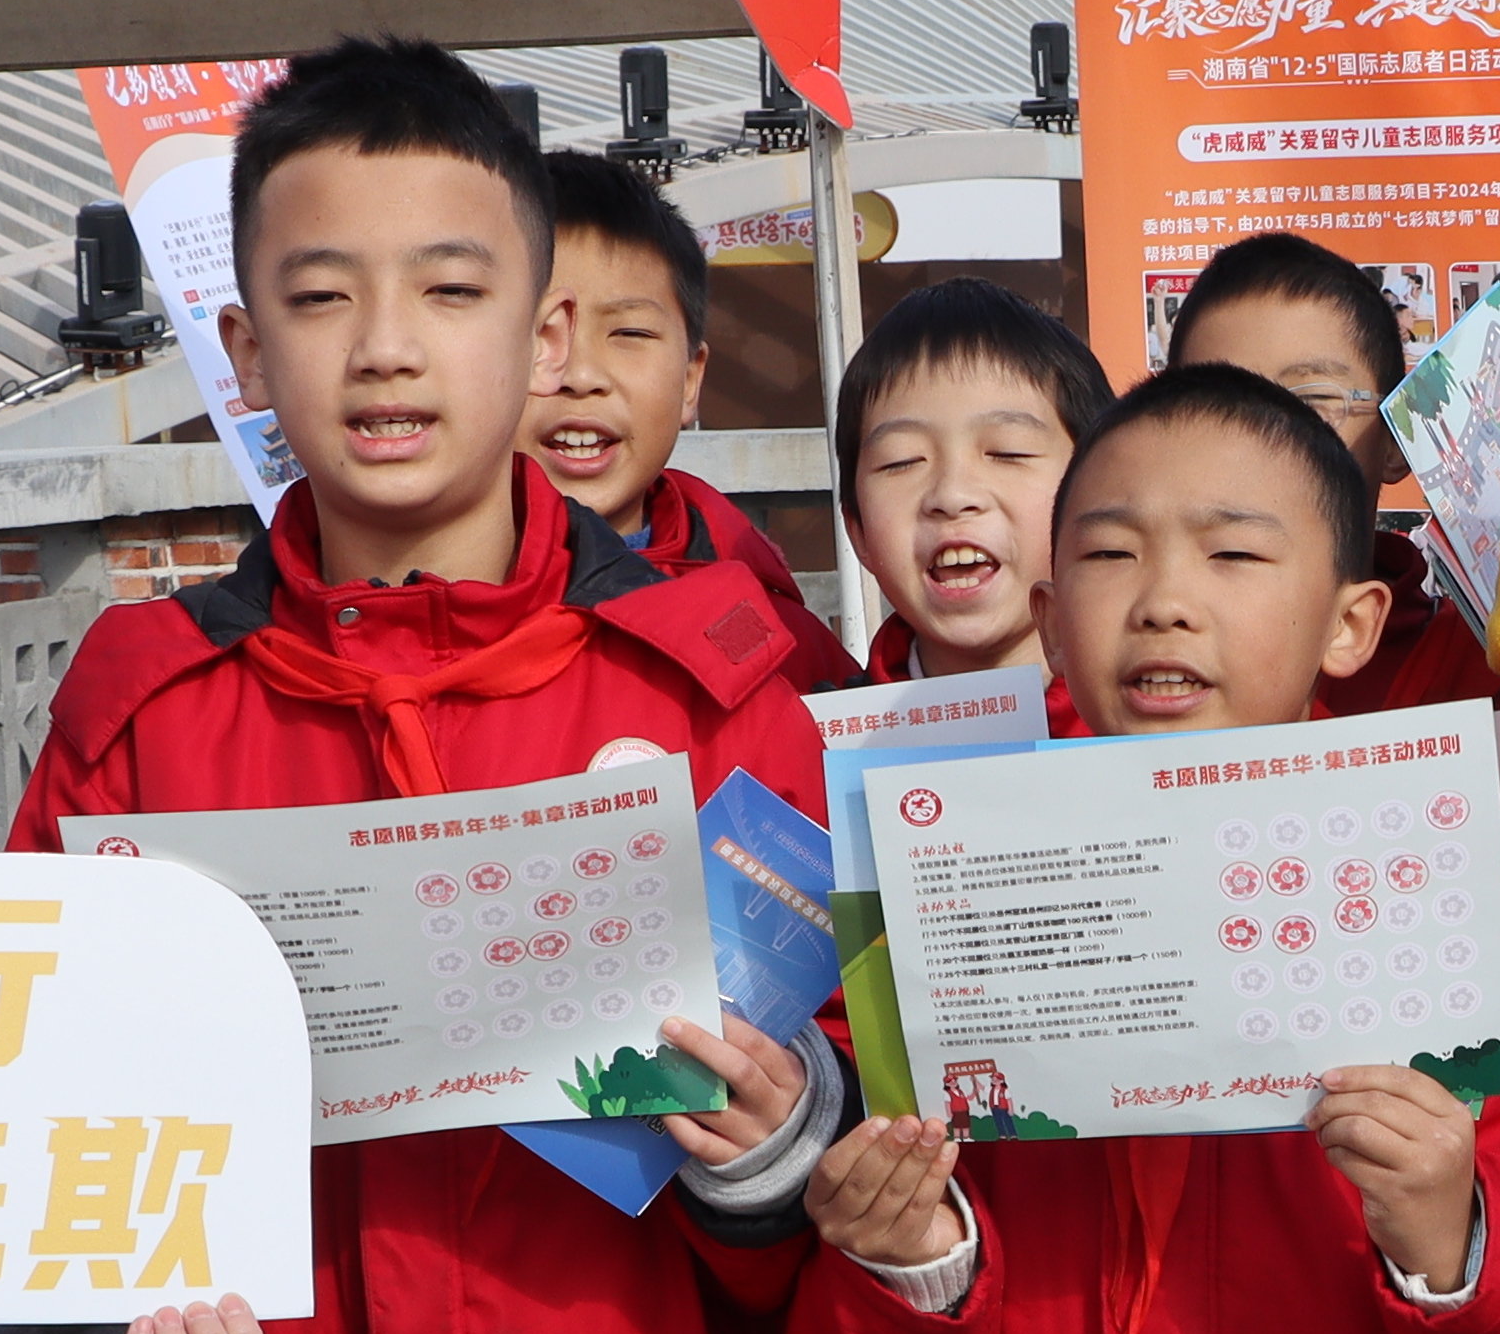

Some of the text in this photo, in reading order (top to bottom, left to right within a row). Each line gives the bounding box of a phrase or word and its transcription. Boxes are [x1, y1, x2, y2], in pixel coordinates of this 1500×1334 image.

[1152, 733, 1462, 791] 志愿服务嘉年华·集章活动规则
[348, 786, 659, 848] 志愿服务嘉年华·集章活动规则
